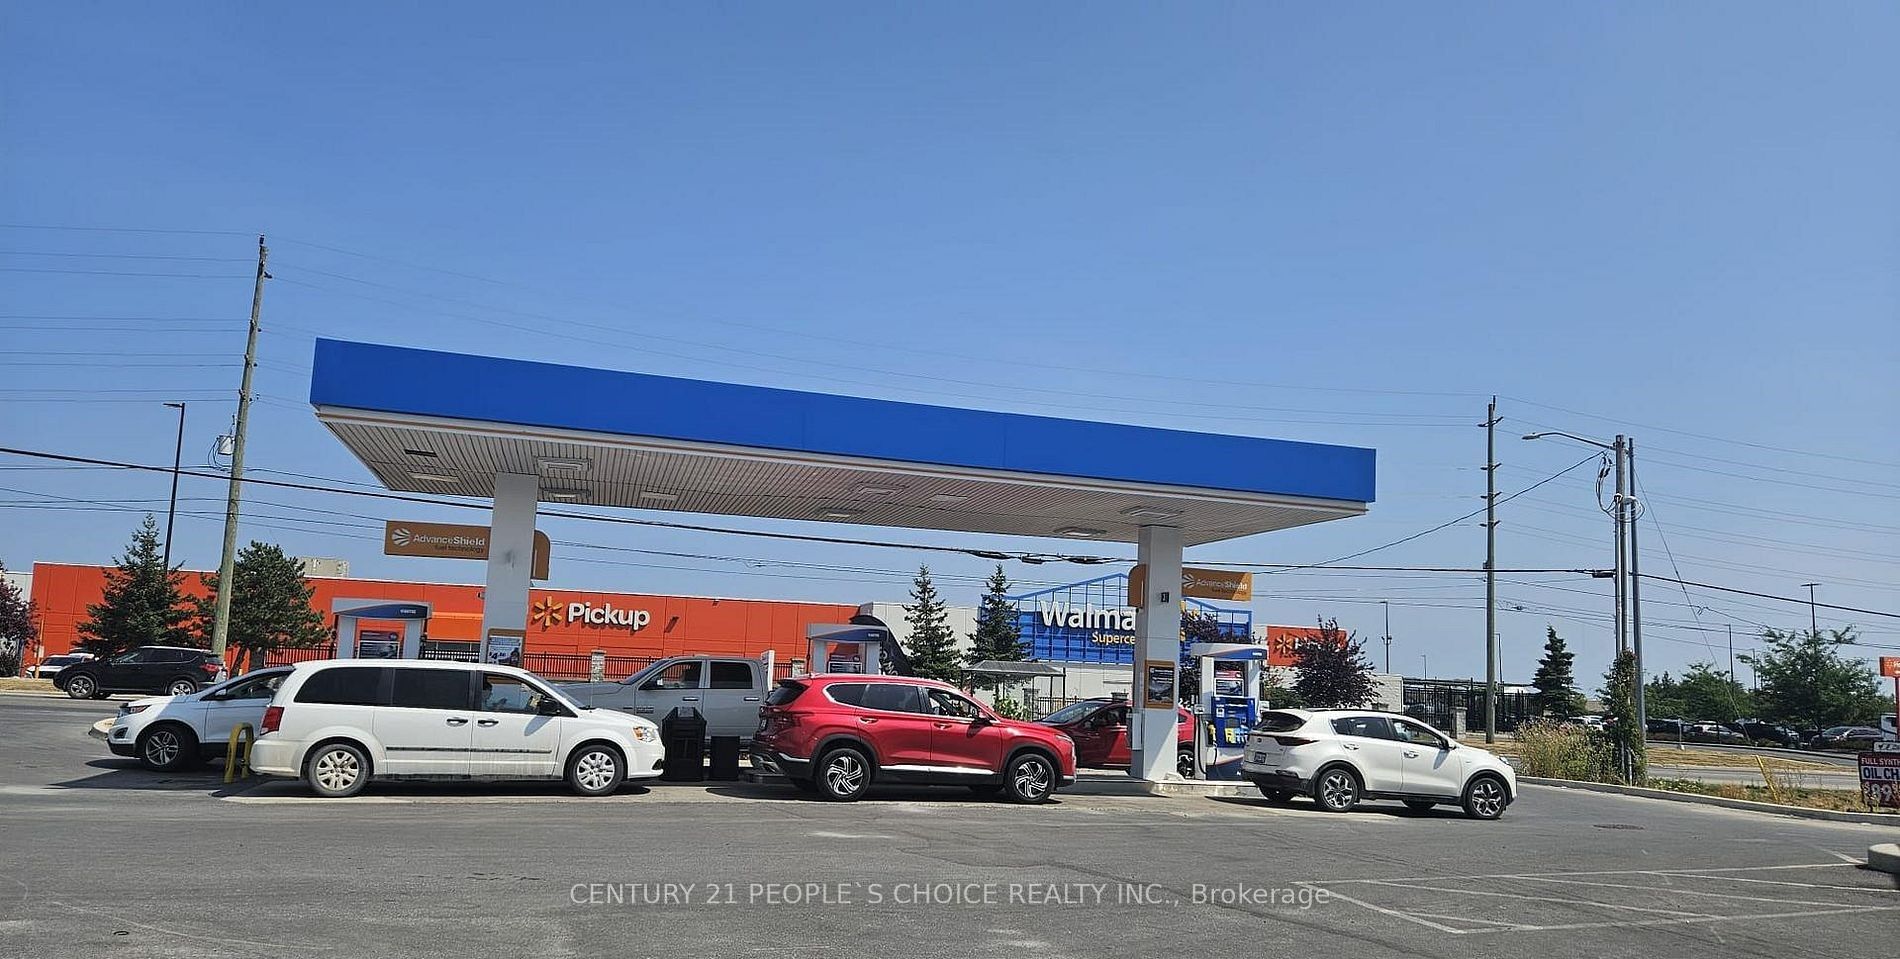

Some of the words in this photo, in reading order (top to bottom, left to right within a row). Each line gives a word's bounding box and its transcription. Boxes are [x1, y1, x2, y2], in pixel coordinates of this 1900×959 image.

[413, 534, 485, 546] AdvanceShield
[568, 602, 651, 630] Pickup
[1040, 600, 1136, 631] Walma
[1092, 632, 1136, 645] Superce
[1861, 757, 1878, 765] FULL
[1863, 767, 1881, 779] OIL
